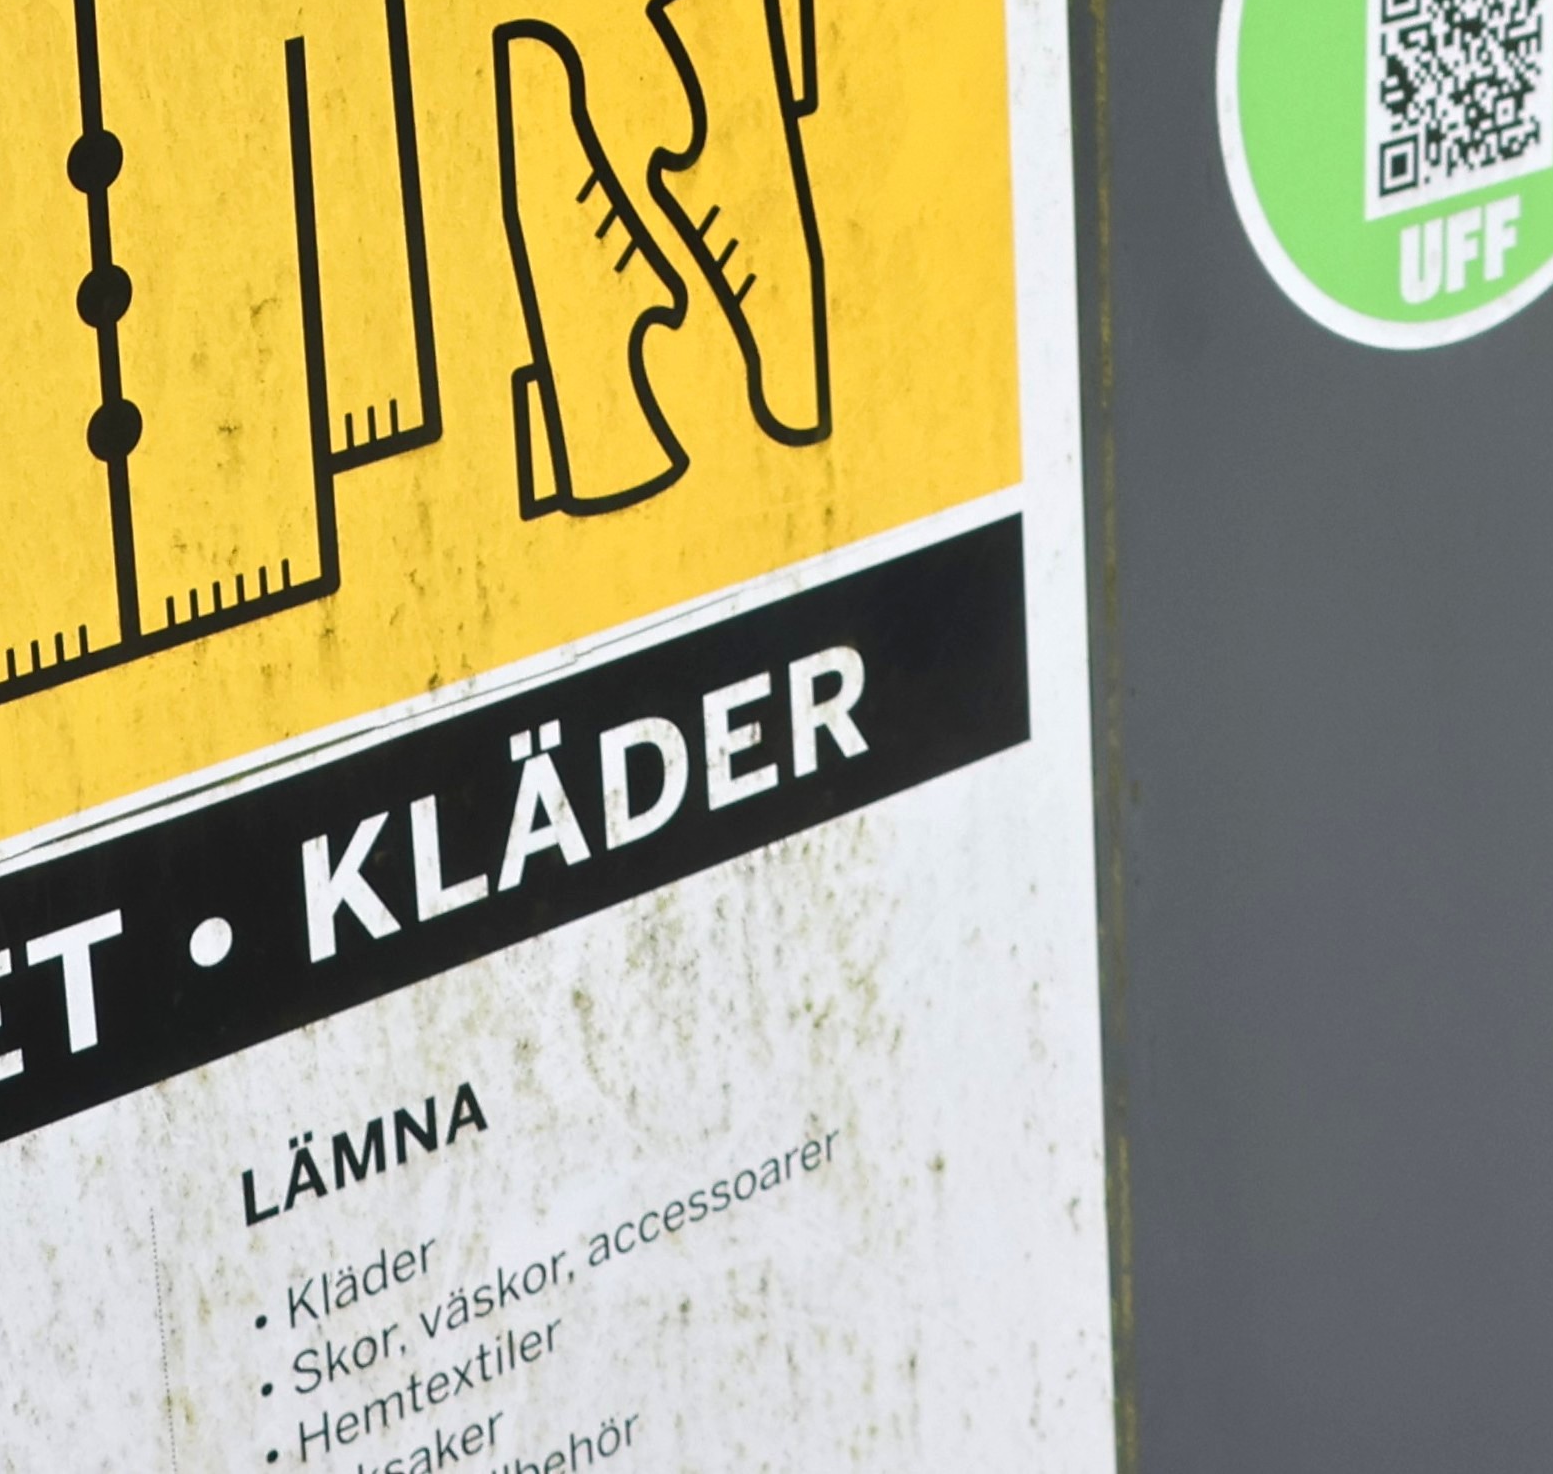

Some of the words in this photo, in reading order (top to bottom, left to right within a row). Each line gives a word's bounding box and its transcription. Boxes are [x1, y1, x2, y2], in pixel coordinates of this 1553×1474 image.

[1399, 194, 1521, 305] UFF
[301, 645, 870, 964] KLÄDER
[241, 1081, 489, 1228] LÄMNA
[287, 1239, 437, 1330] Kläder
[292, 1322, 408, 1396] Skor,
[420, 1250, 576, 1340] väskor,
[588, 1129, 840, 1268] accessoarer
[298, 1316, 563, 1463] Hemtextiler
[357, 1410, 504, 1474] saker
